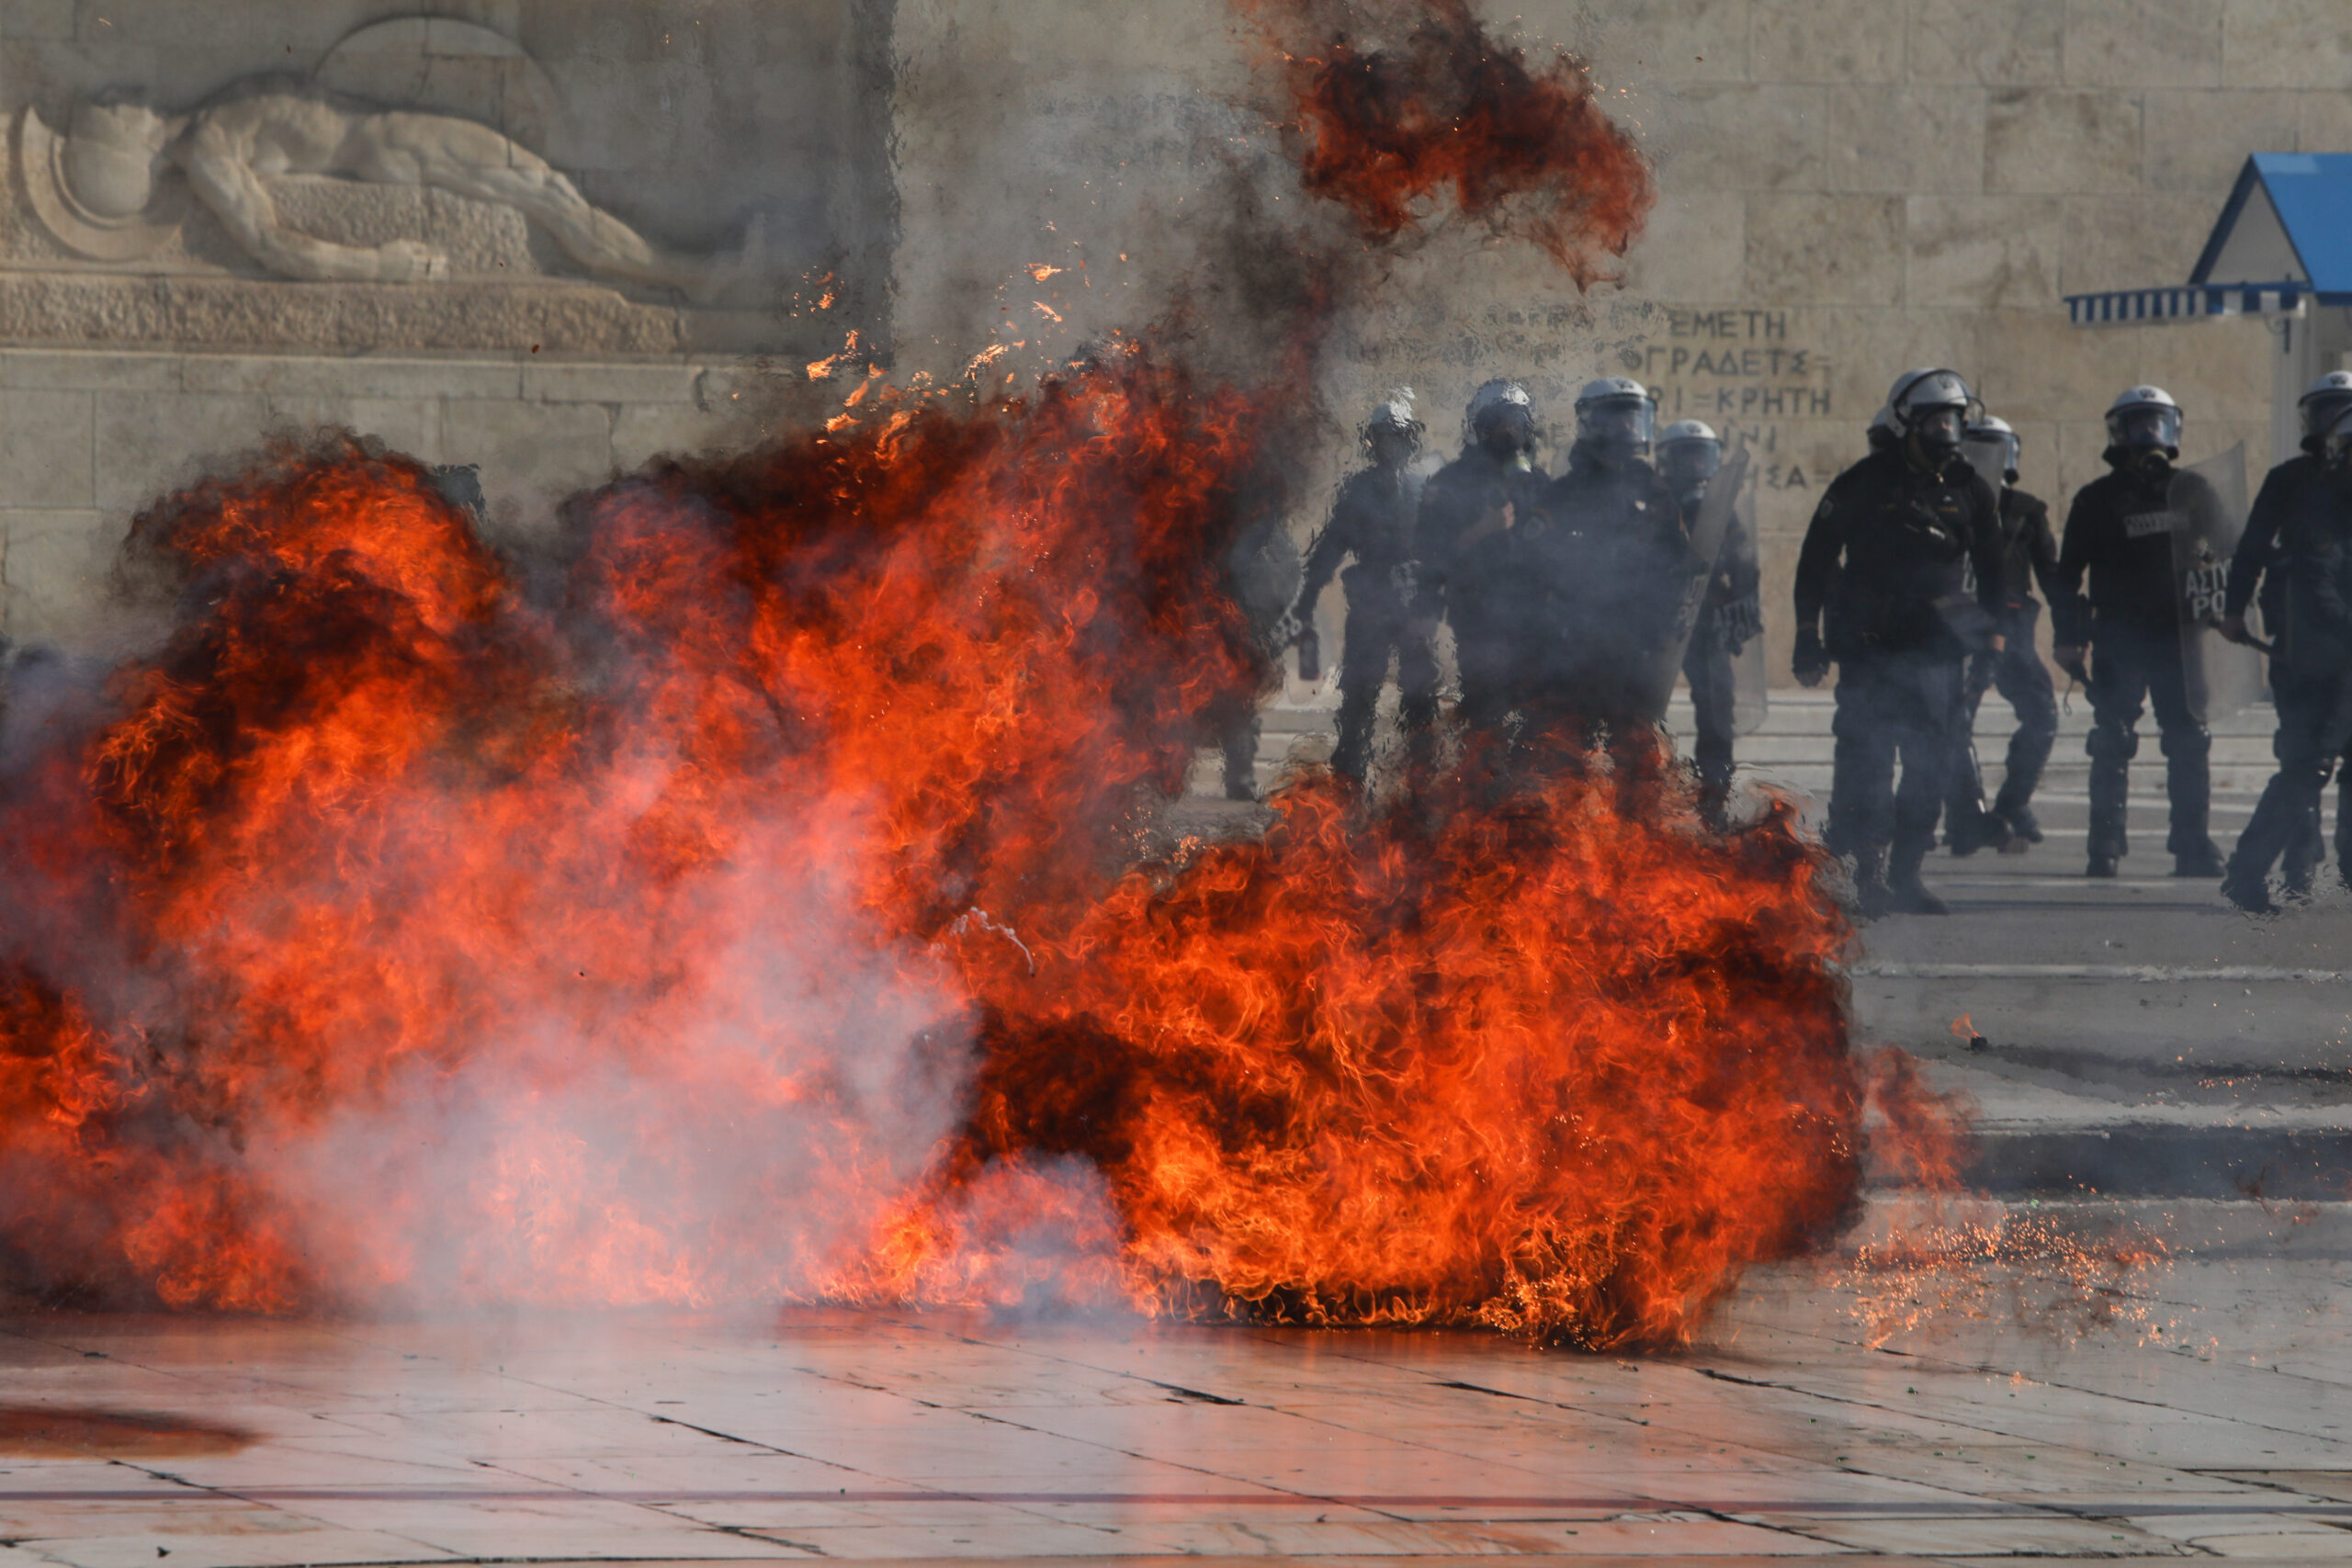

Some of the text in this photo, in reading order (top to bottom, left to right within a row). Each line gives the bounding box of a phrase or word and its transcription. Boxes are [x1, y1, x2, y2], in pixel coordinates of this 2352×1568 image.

[1645, 311, 1785, 338] ΕΜΕΤΗ
[1620, 345, 1809, 376] ΟΓΡΑΔΕΤΣ
[1743, 464, 1807, 490] ΗΣΑ
[2186, 558, 2233, 598] ΑΣΤΥ
[2192, 591, 2227, 619] PO
